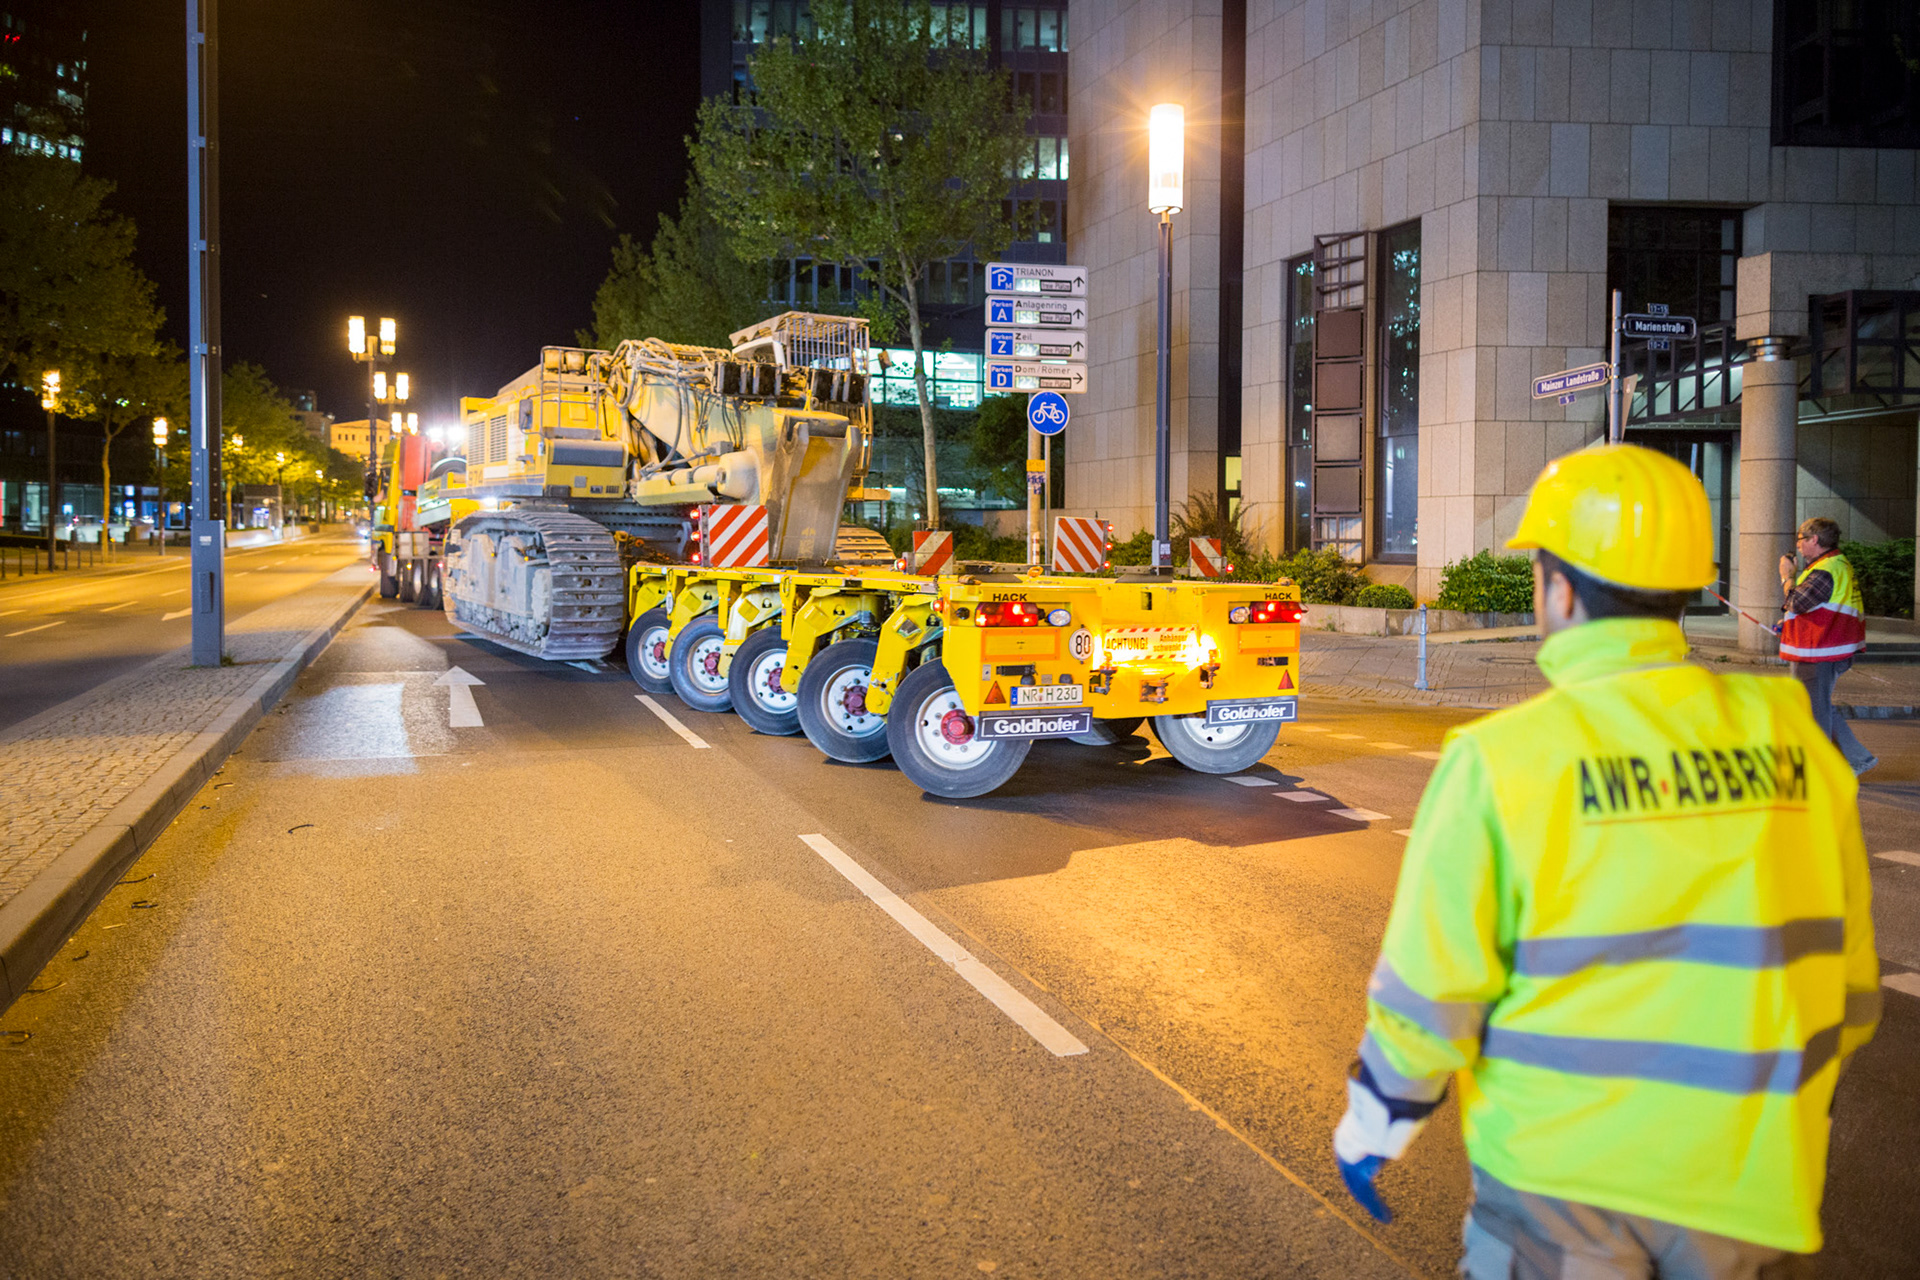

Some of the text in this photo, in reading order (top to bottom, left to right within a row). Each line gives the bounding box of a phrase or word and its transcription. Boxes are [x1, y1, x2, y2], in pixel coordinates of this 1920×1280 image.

[1016, 267, 1054, 277] TRIANON
[997, 274, 1007, 287] P
[1016, 300, 1068, 311] Anlagenring
[997, 308, 1007, 321] A
[1635, 321, 1686, 334] Marienstraße
[1015, 332, 1032, 341] Zeil
[997, 341, 1007, 353] Z
[996, 373, 1007, 386] D
[1541, 370, 1600, 392] Mainzer Landstraße
[901, 582, 920, 591] HACK
[993, 593, 1027, 602] HACK
[1265, 592, 1292, 601] HACK
[1075, 634, 1092, 655] 80
[1106, 637, 1149, 651] ACHTUNG!
[1022, 686, 1078, 702] NR H 230
[1217, 704, 1287, 721] Goldhofer
[993, 717, 1080, 734] Goldhofer
